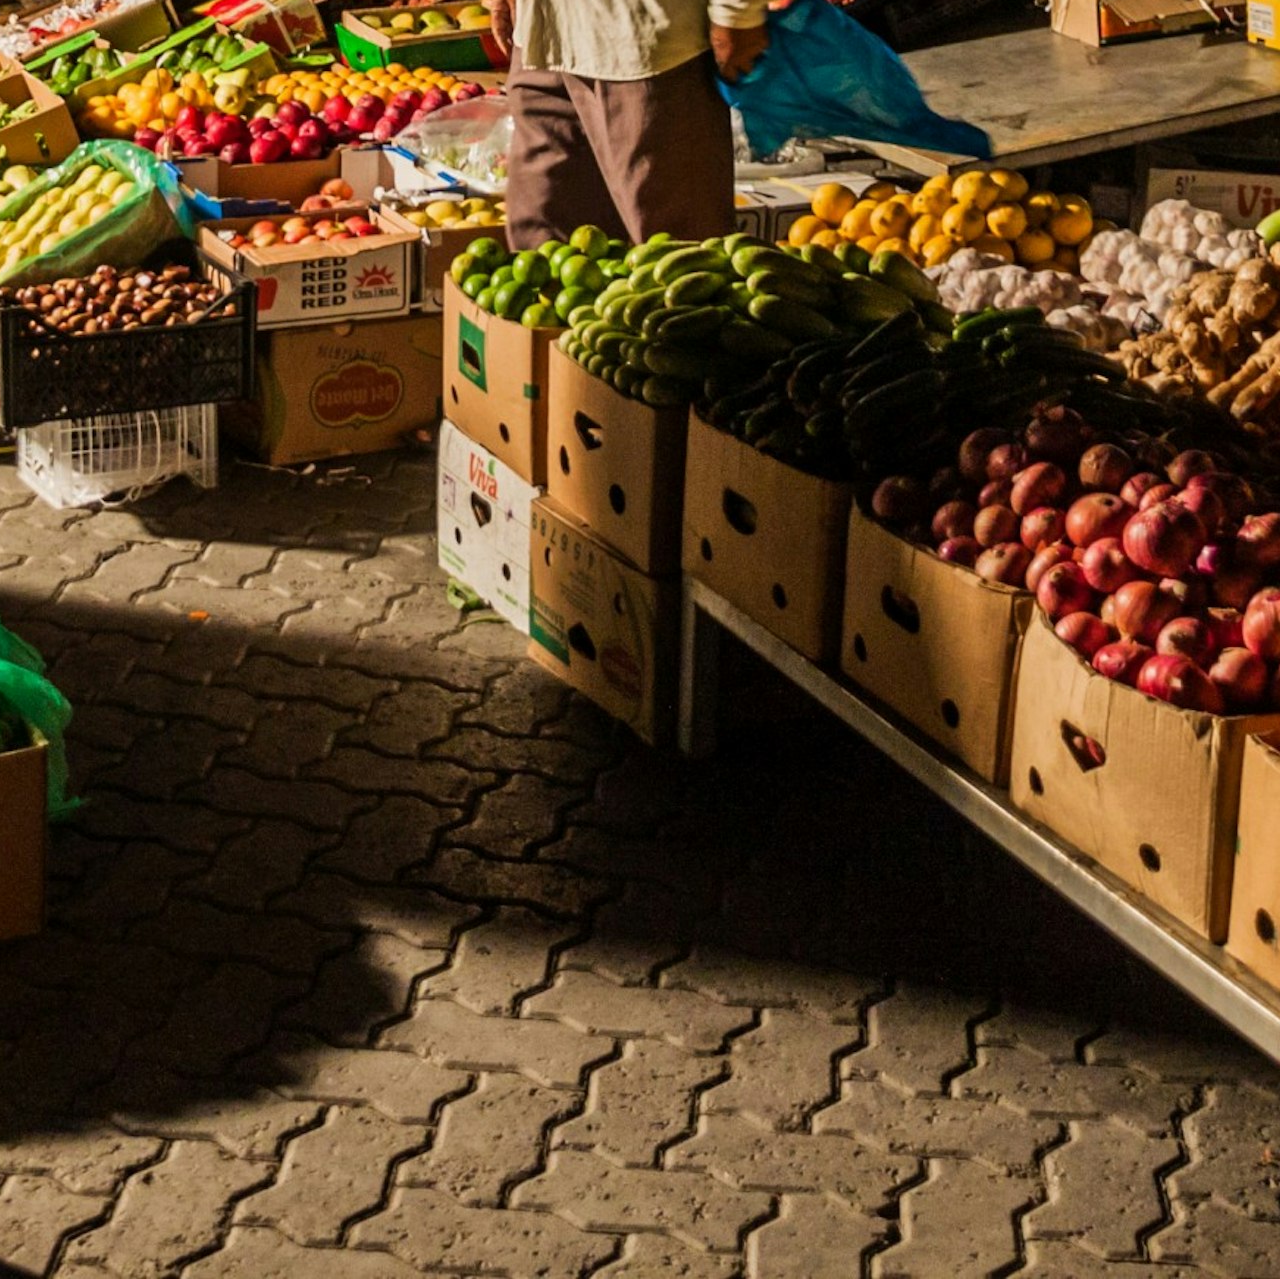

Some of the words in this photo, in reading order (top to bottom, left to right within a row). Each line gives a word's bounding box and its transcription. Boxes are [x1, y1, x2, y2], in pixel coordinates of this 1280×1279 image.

[301, 257, 348, 269] RED
[301, 269, 348, 283] RED
[301, 282, 348, 296] RED
[301, 295, 348, 310] RED
[469, 452, 498, 500] Viva
